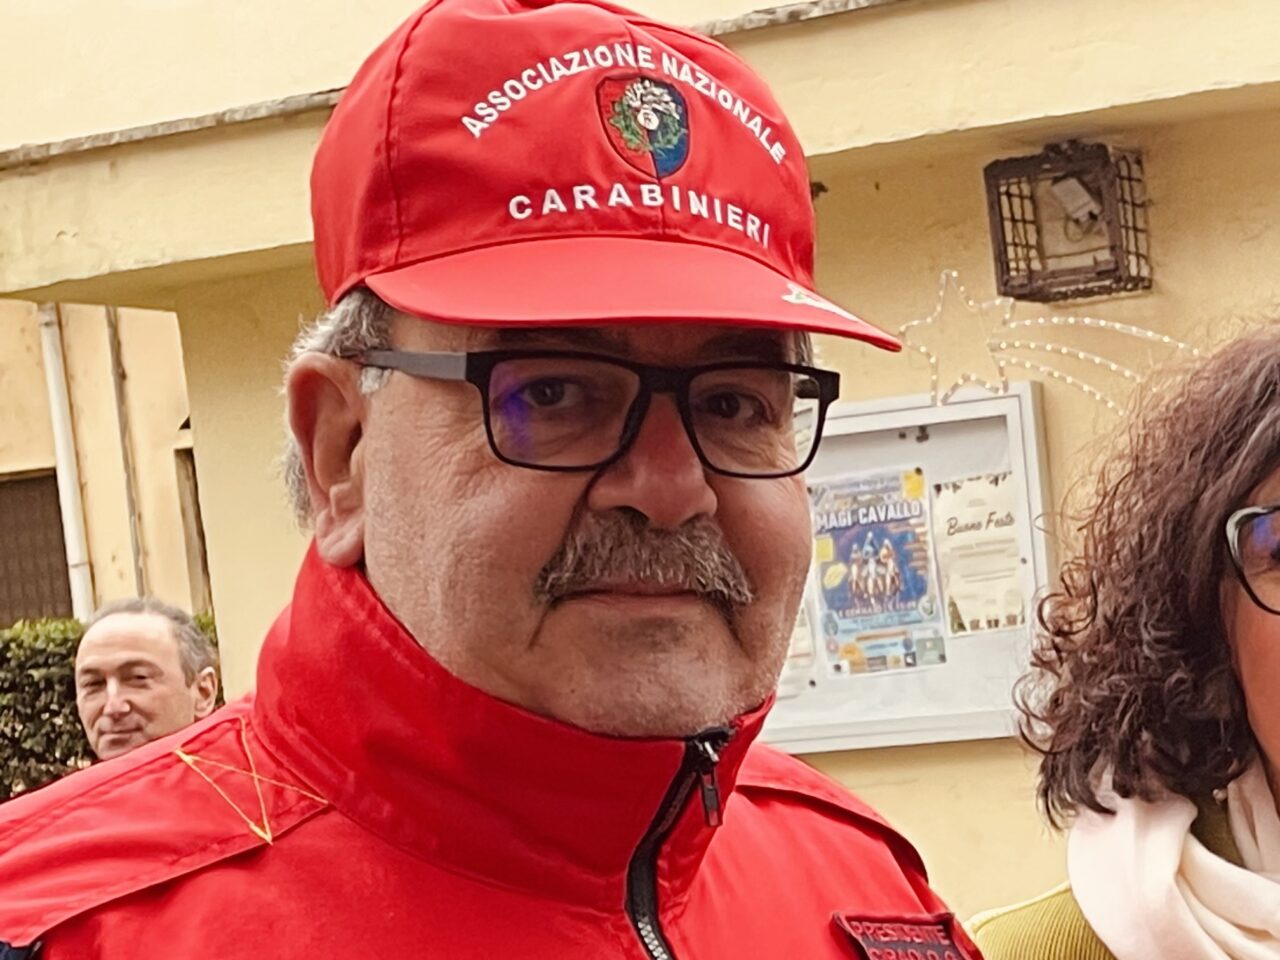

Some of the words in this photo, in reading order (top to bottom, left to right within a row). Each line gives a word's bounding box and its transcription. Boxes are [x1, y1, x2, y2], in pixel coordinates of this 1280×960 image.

[461, 43, 655, 138] ASSOCIAZIONE
[662, 53, 787, 164] NAZIONALE
[509, 183, 771, 249] CARABINIERI
[859, 501, 921, 525] CAVALLO
